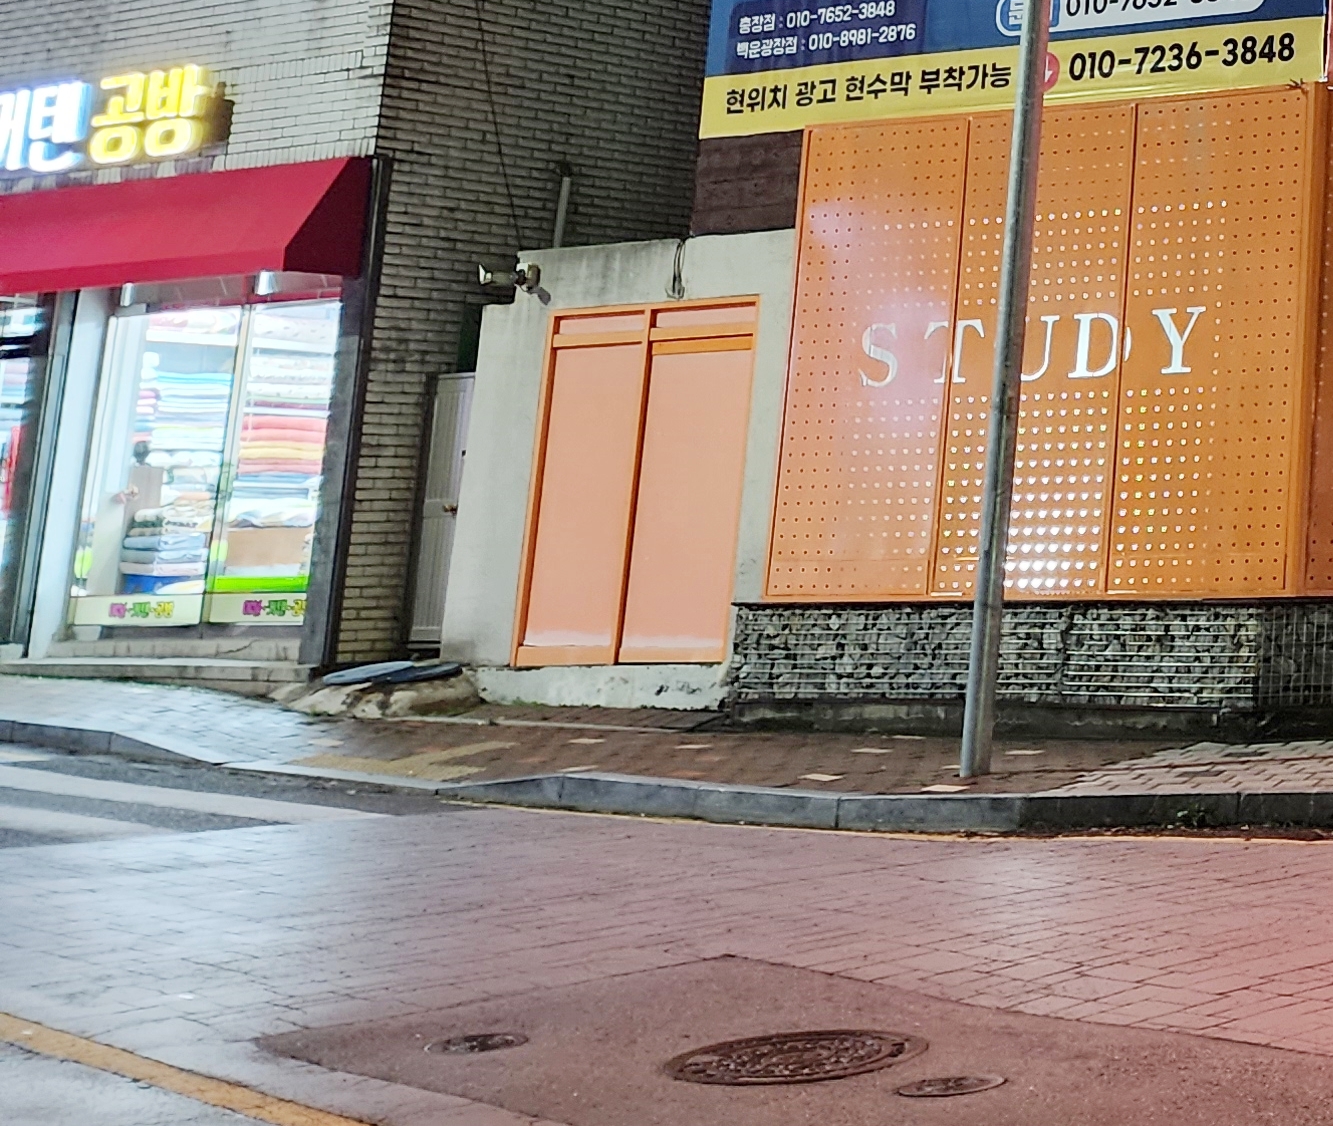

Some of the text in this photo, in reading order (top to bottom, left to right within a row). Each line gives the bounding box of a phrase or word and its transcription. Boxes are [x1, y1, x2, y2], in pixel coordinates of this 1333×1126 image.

[786, 0, 896, 29] 010-7652-3848
[736, 24, 917, 59] 백운광장점 010-8981-2876
[1068, 32, 1296, 82] 010-7236-3848
[726, 62, 1012, 114] 현위치 광고 현수막 부착가능
[89, 64, 209, 164] 공방
